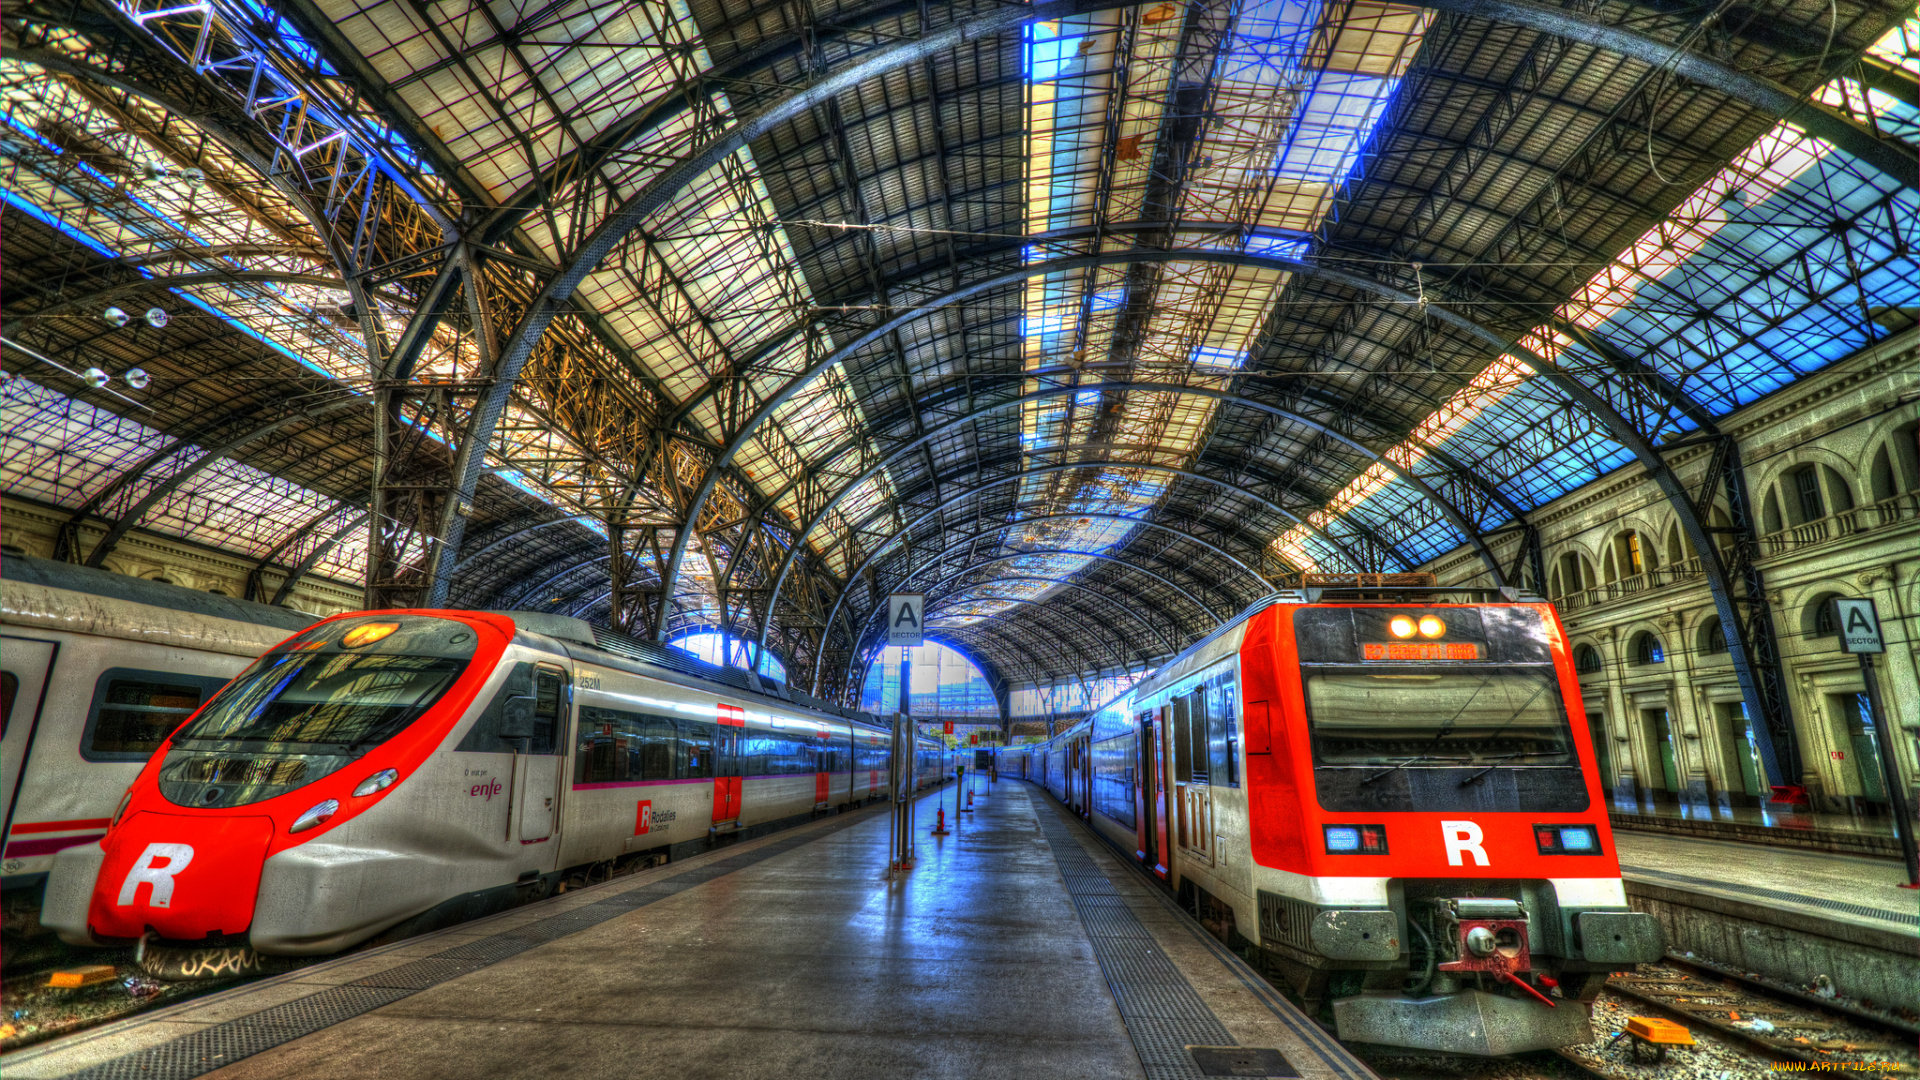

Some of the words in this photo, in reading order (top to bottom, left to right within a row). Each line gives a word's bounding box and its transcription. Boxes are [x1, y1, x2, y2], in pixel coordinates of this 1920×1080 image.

[895, 602, 918, 628] A
[1847, 606, 1873, 634] A
[1846, 637, 1880, 645] SECTOR
[580, 676, 601, 690] 252M
[464, 777, 502, 802] enfe
[651, 810, 676, 824] Rodalies
[1441, 820, 1491, 867] R
[117, 842, 195, 909] R
